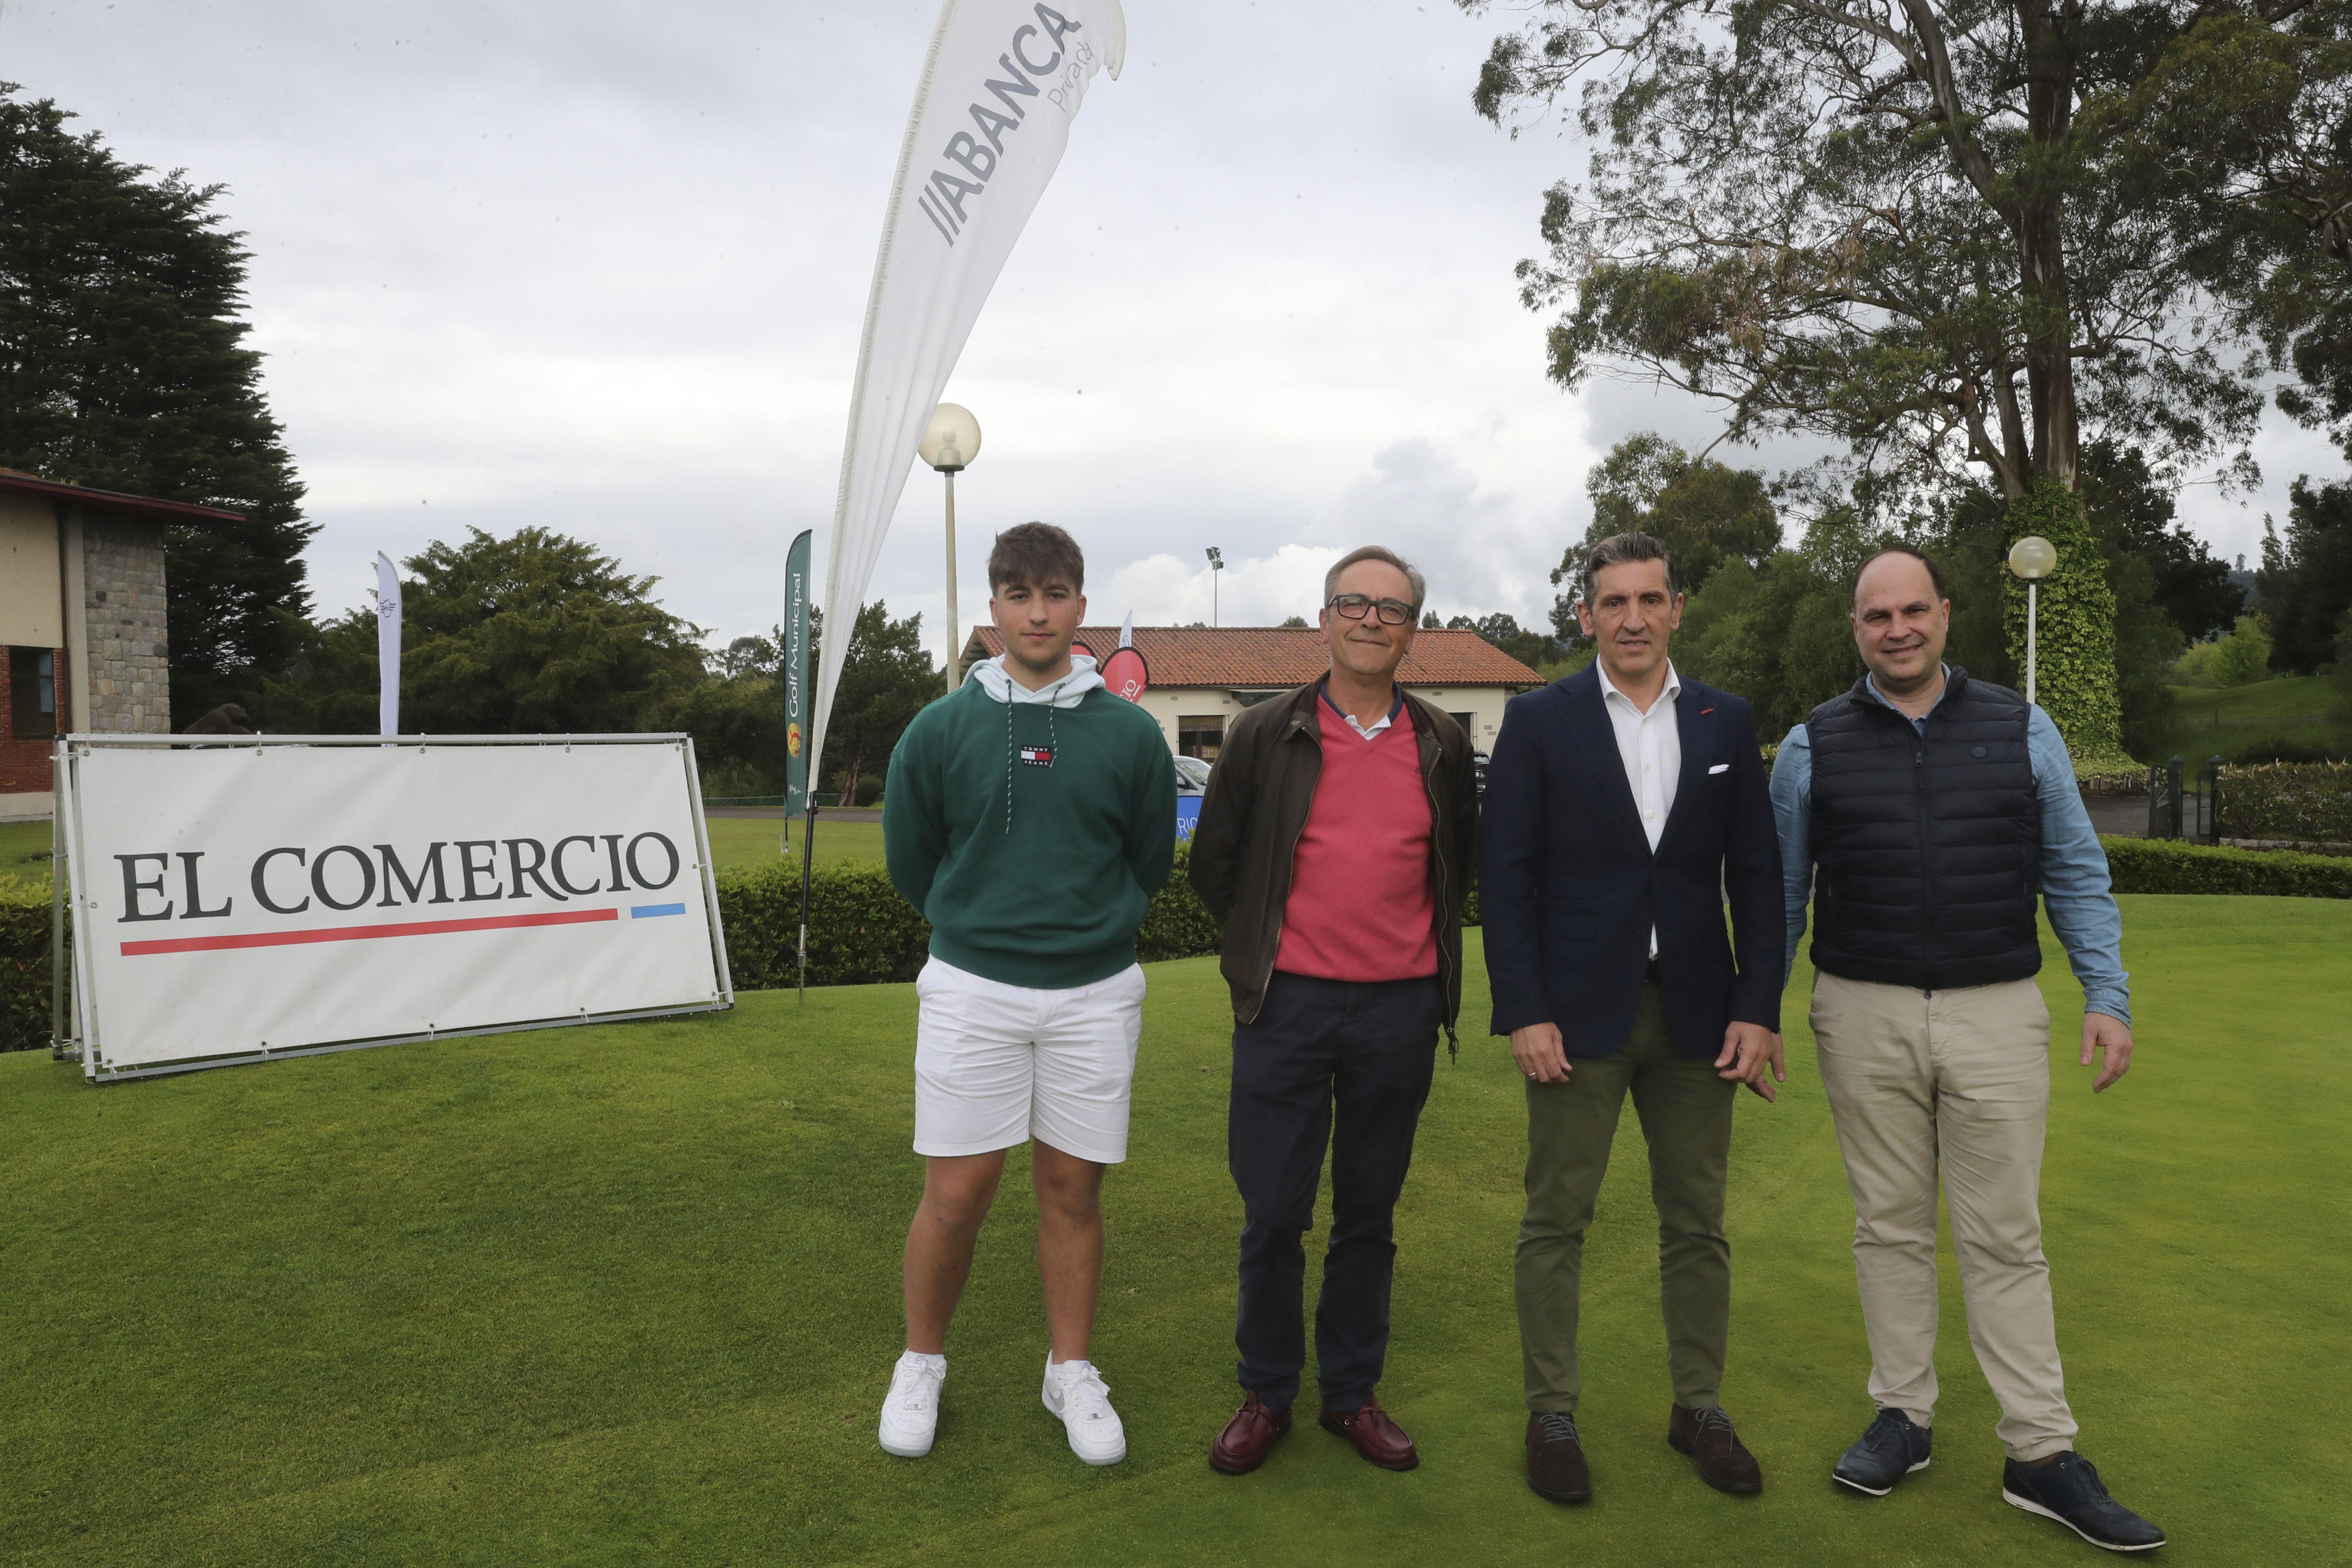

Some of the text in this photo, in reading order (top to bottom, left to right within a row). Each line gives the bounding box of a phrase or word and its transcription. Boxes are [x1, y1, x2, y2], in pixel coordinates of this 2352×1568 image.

[789, 573, 802, 718] Golf Municipal
[113, 832, 680, 922] EL COMERCIO
